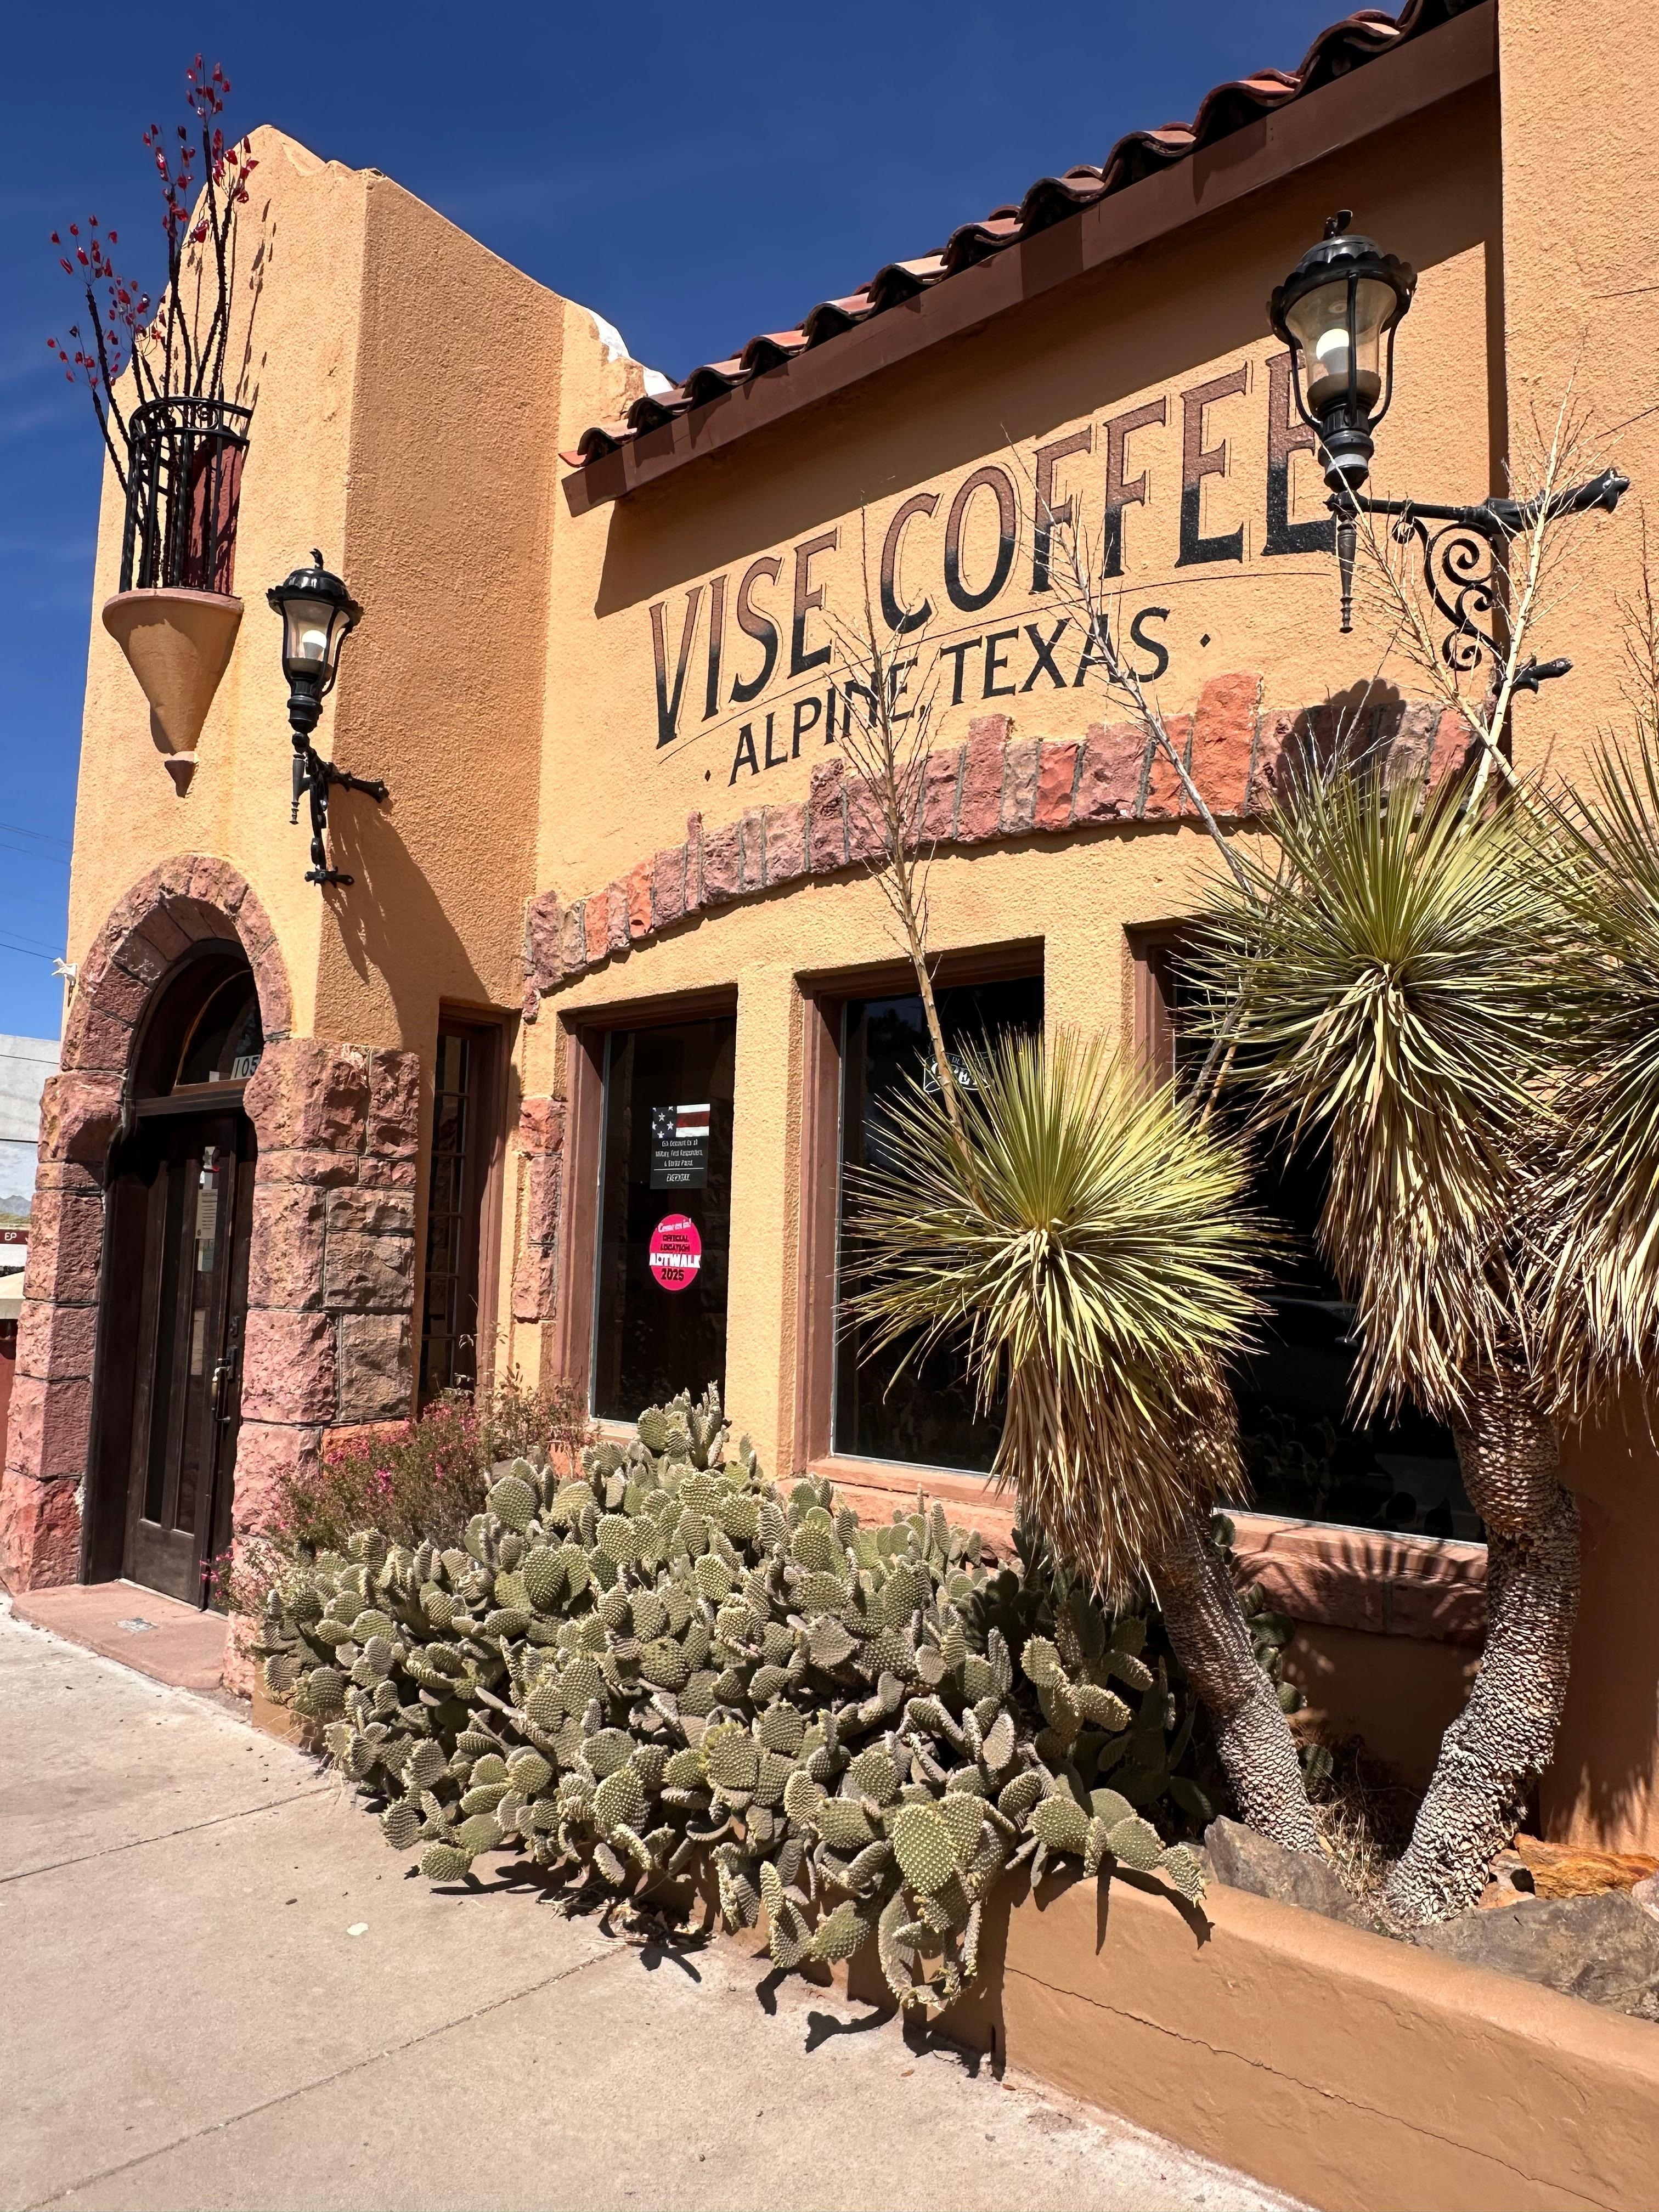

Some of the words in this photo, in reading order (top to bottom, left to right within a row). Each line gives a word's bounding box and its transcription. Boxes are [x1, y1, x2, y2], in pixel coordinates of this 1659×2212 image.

[649, 526, 839, 749] VISE
[880, 349, 1337, 634] COFFEE
[940, 607, 1171, 706] TEXAS
[234, 1057, 259, 1078] 105
[660, 1243, 690, 1251] LOCATION
[650, 1252, 701, 1268] ARTWALK
[661, 1268, 685, 1281] 2025
